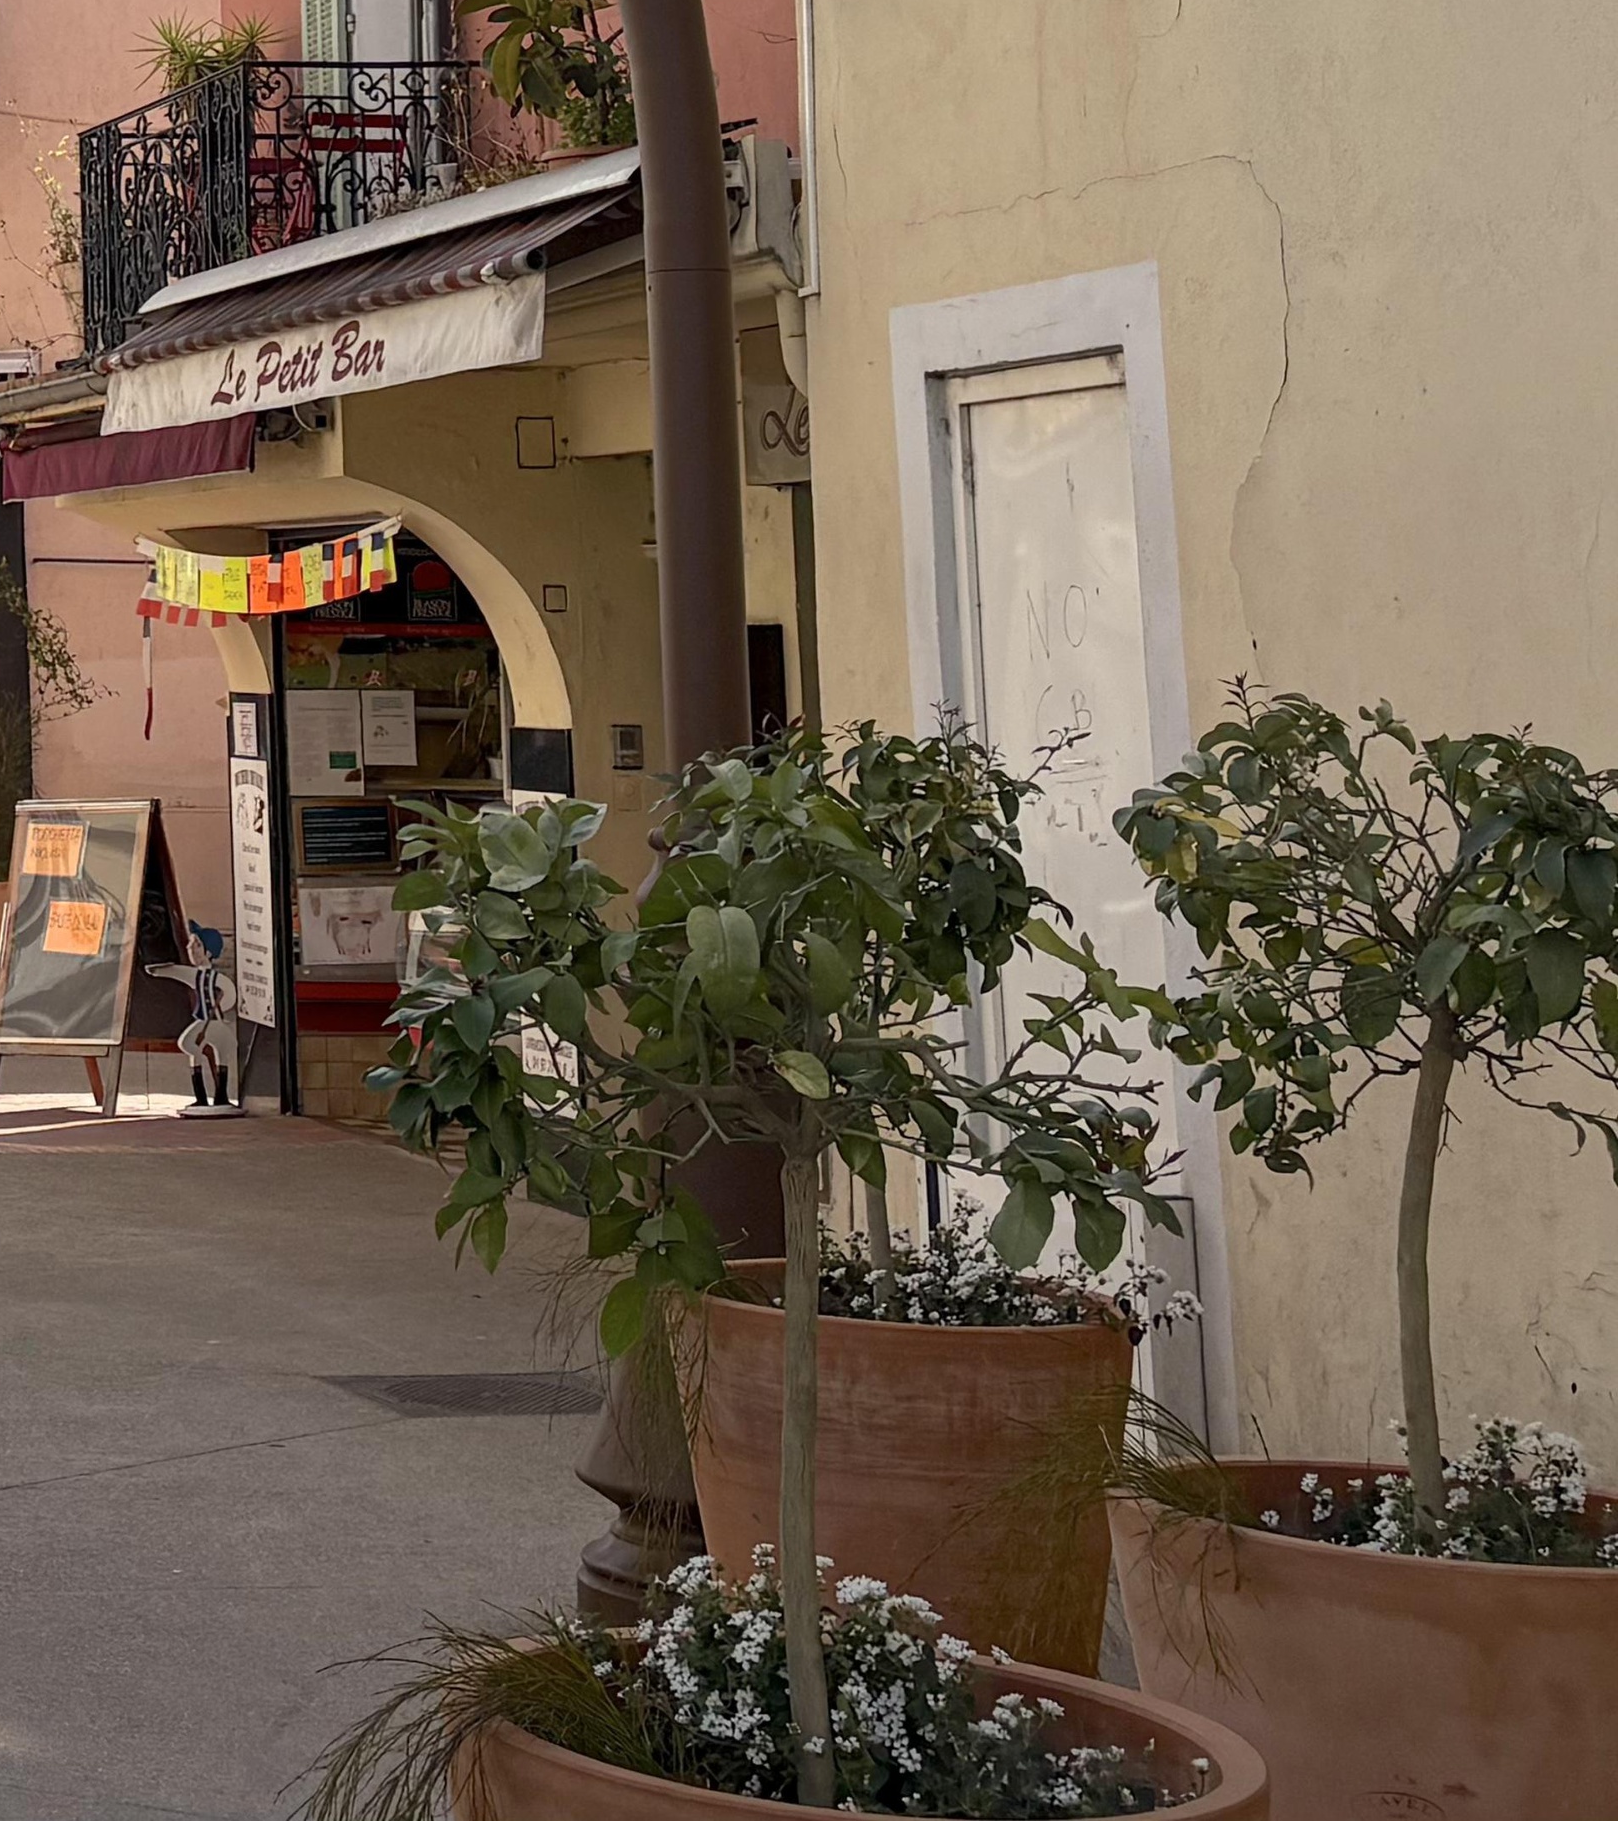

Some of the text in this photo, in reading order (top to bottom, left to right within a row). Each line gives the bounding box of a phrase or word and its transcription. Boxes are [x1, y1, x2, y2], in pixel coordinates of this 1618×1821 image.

[211, 319, 386, 406] Le Petit Bar
